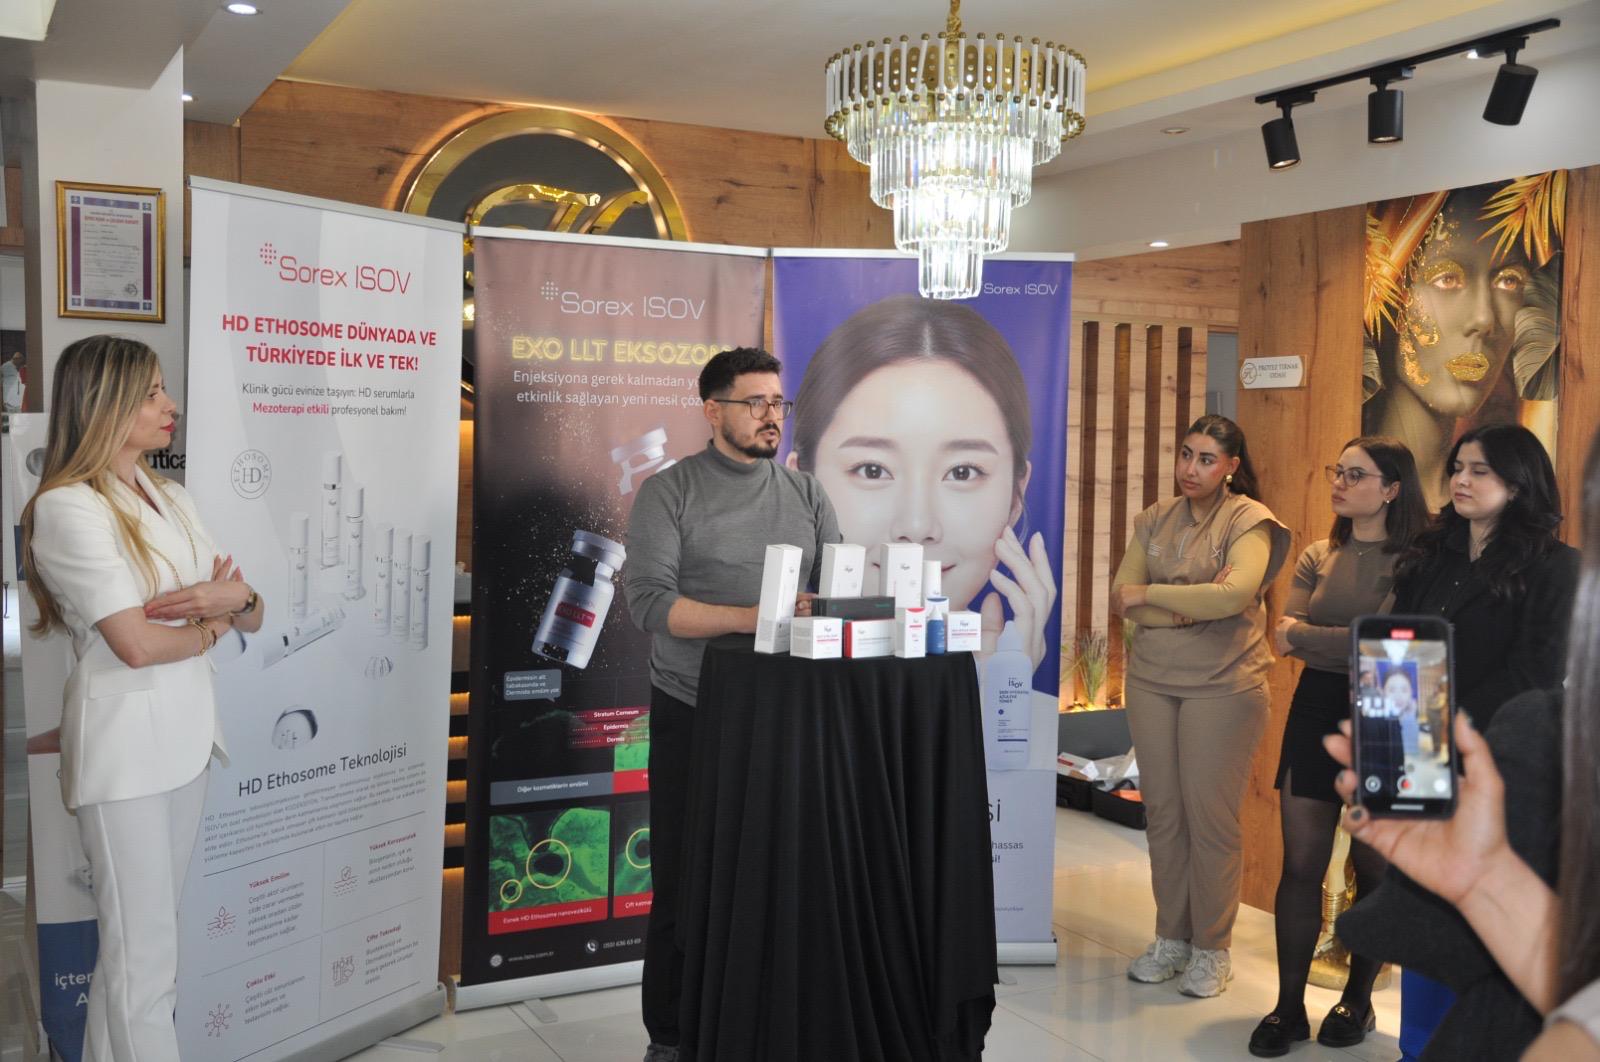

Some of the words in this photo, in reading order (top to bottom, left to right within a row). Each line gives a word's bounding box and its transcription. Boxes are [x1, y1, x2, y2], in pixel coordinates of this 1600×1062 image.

[279, 255, 348, 287] Sorex
[355, 265, 411, 294] ISOV
[984, 283, 1020, 294] Sorex
[1025, 284, 1058, 295] ISOV
[560, 292, 634, 316] Sorex
[643, 296, 705, 319] ISOV
[222, 314, 248, 332] HD
[255, 317, 342, 338] ETHOSOME
[348, 322, 416, 344] DÜNYADA
[420, 331, 436, 346] VE
[246, 342, 335, 366] TÜRKİYEDE
[341, 348, 362, 368] İLK
[366, 354, 384, 369] VE
[389, 355, 419, 370] TEK!
[512, 336, 562, 360] EXO
[570, 339, 608, 362] LLT
[614, 340, 733, 365] EKSOZO
[242, 384, 269, 395] Klinik
[272, 385, 293, 397] gücü
[296, 386, 324, 396] evinize
[359, 388, 371, 397] HD
[373, 389, 415, 399] serumlarla
[514, 371, 587, 386] Enjeksiyona
[591, 374, 624, 388] gerek
[628, 376, 684, 387] kalmadan
[253, 403, 304, 415] Mezoterapi
[307, 405, 329, 415] etkili
[331, 406, 379, 416] profesyonel
[381, 406, 407, 416] bakım!
[517, 391, 561, 402] etkinlik
[566, 392, 618, 406] sağlayan
[622, 394, 647, 406] yeni
[650, 395, 676, 405] nesil
[238, 777, 262, 797] HD
[267, 763, 336, 790] Ethosome
[340, 742, 407, 771] Teknolojisi
